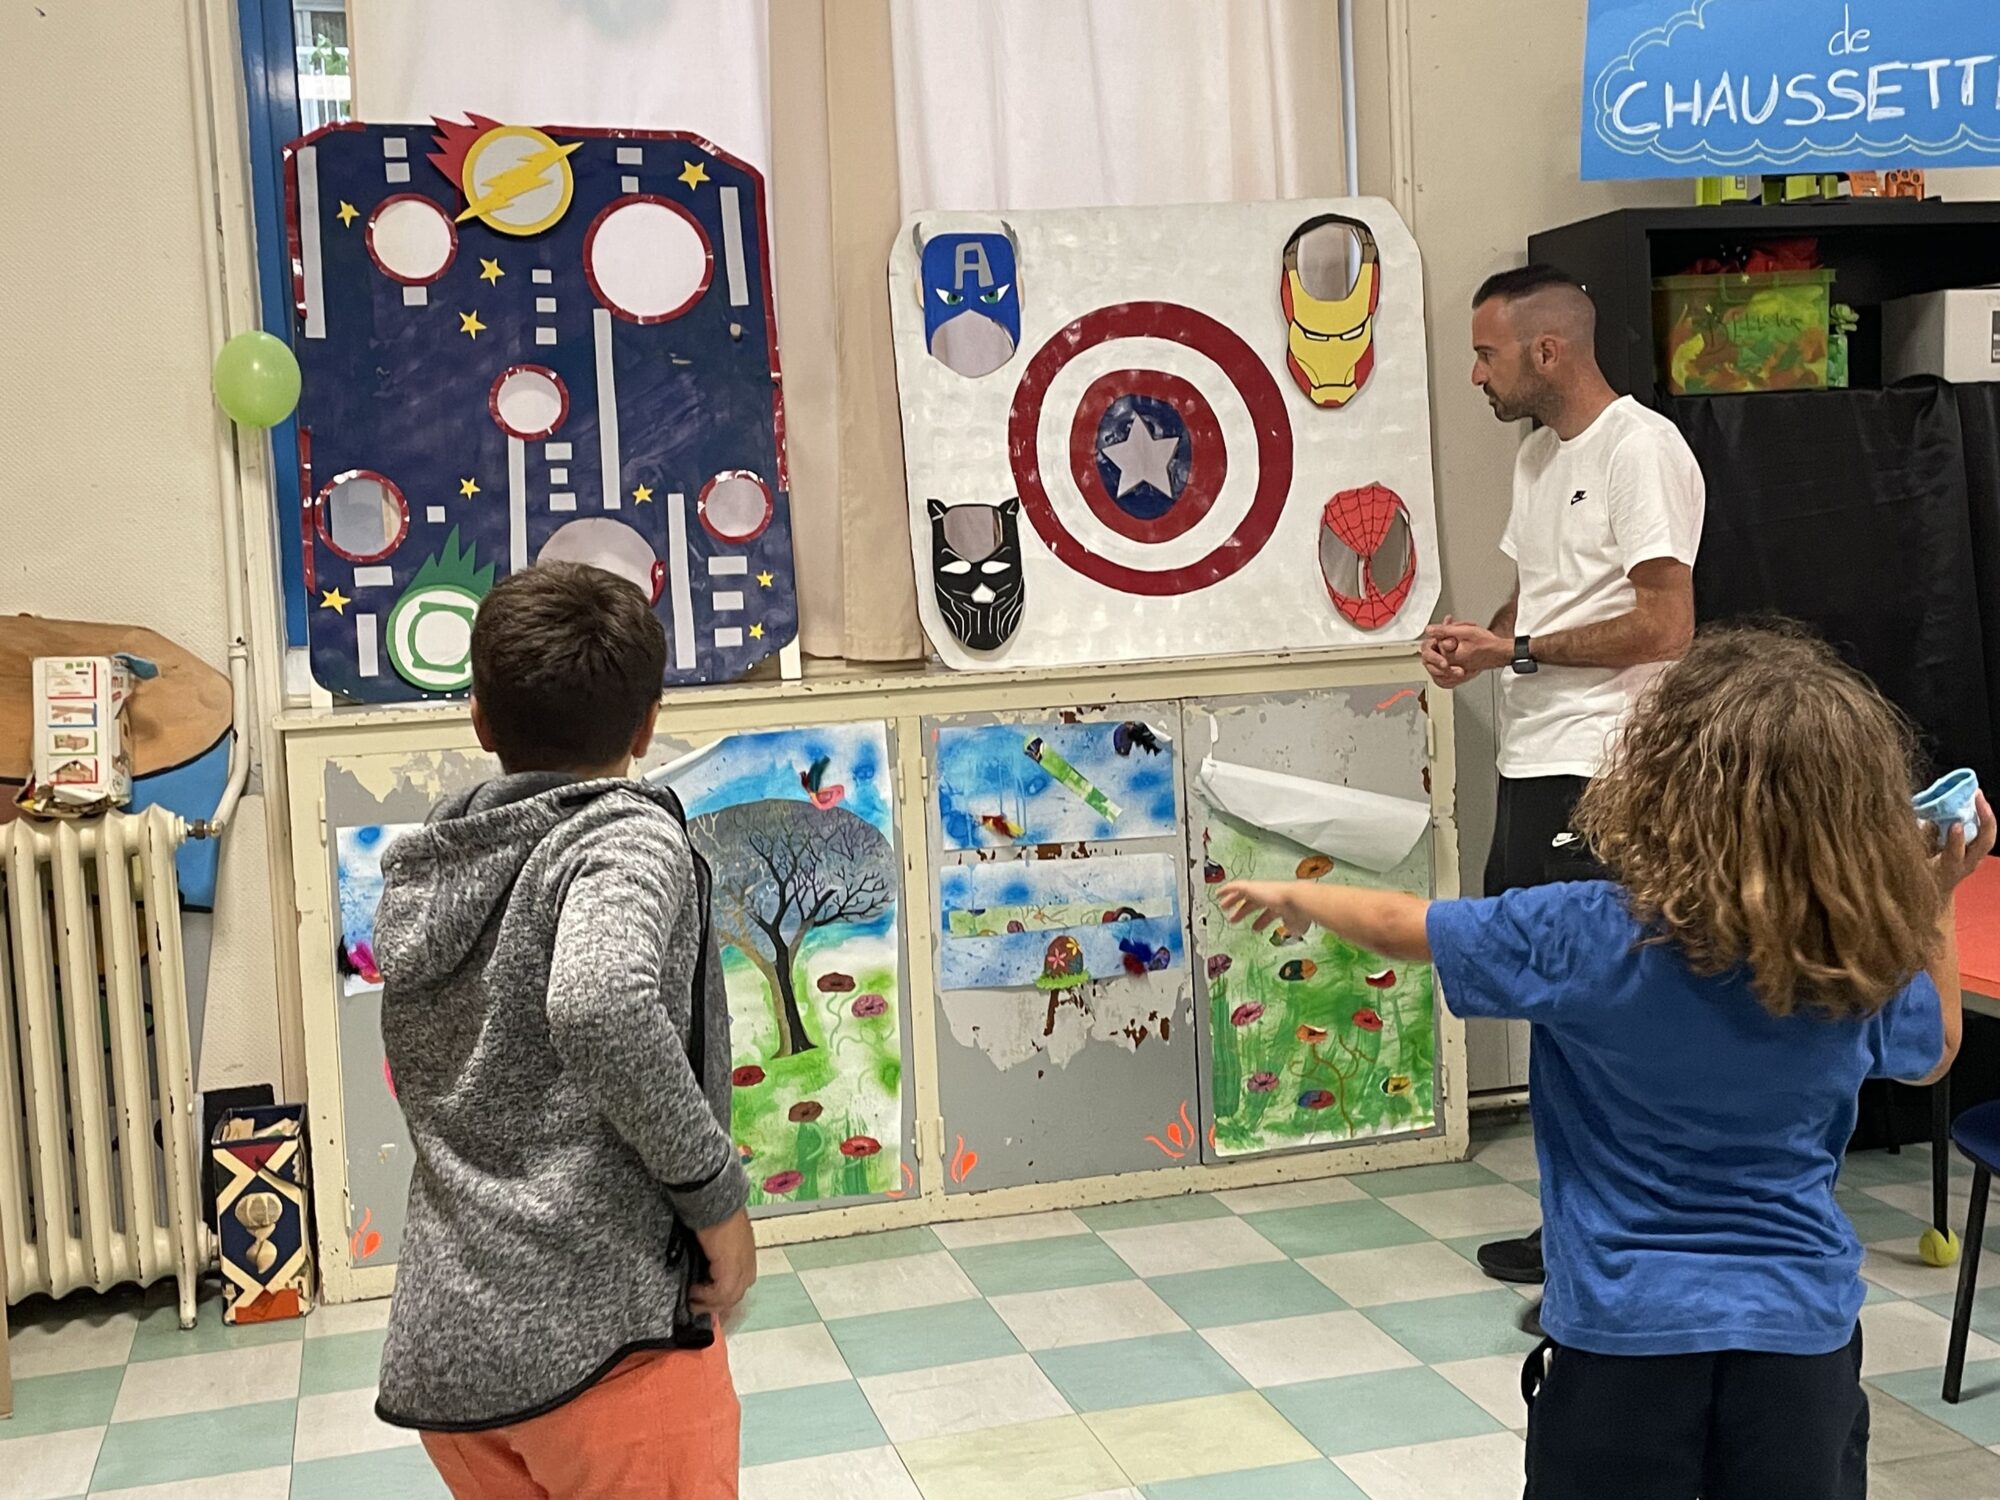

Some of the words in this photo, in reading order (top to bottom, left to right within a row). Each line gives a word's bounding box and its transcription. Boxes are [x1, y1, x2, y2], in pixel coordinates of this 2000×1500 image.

[1827, 3, 1871, 55] de
[1612, 54, 2000, 136] CHAUSSETT
[954, 241, 995, 290] A
